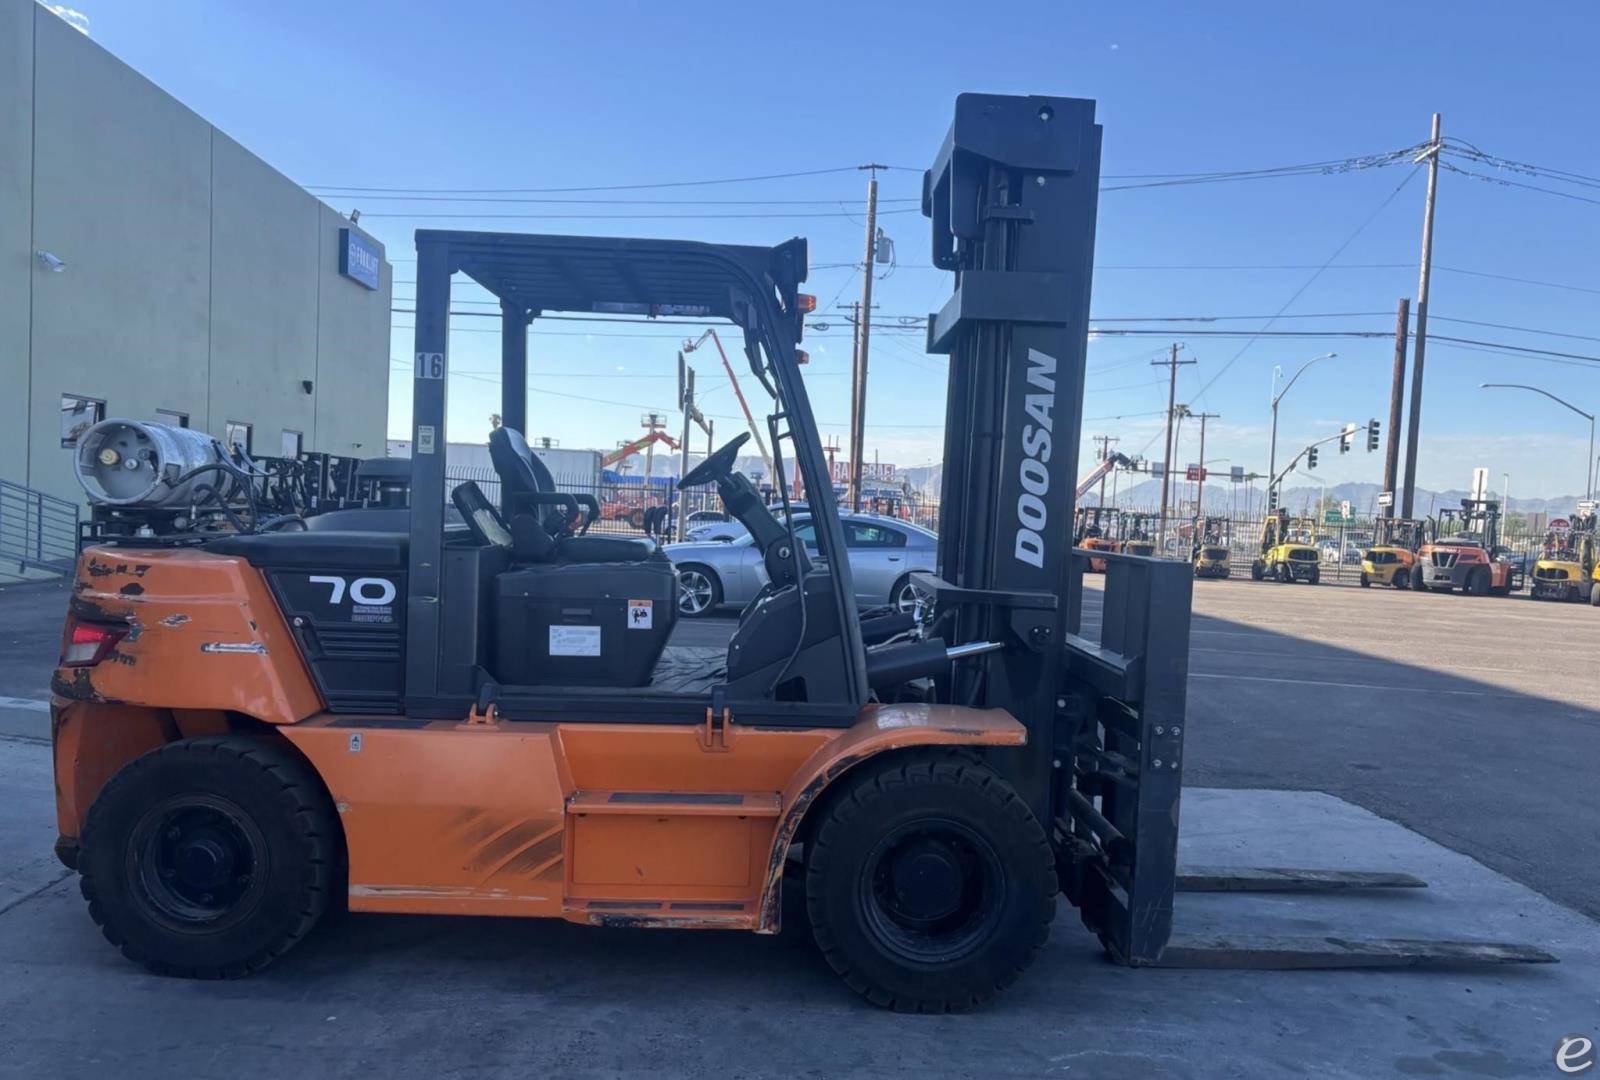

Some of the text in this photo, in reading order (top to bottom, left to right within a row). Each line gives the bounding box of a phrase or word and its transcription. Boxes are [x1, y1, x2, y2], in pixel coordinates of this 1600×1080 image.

[418, 353, 442, 378] 16
[1014, 347, 1057, 569] DOOSAN
[309, 576, 396, 605] 70
